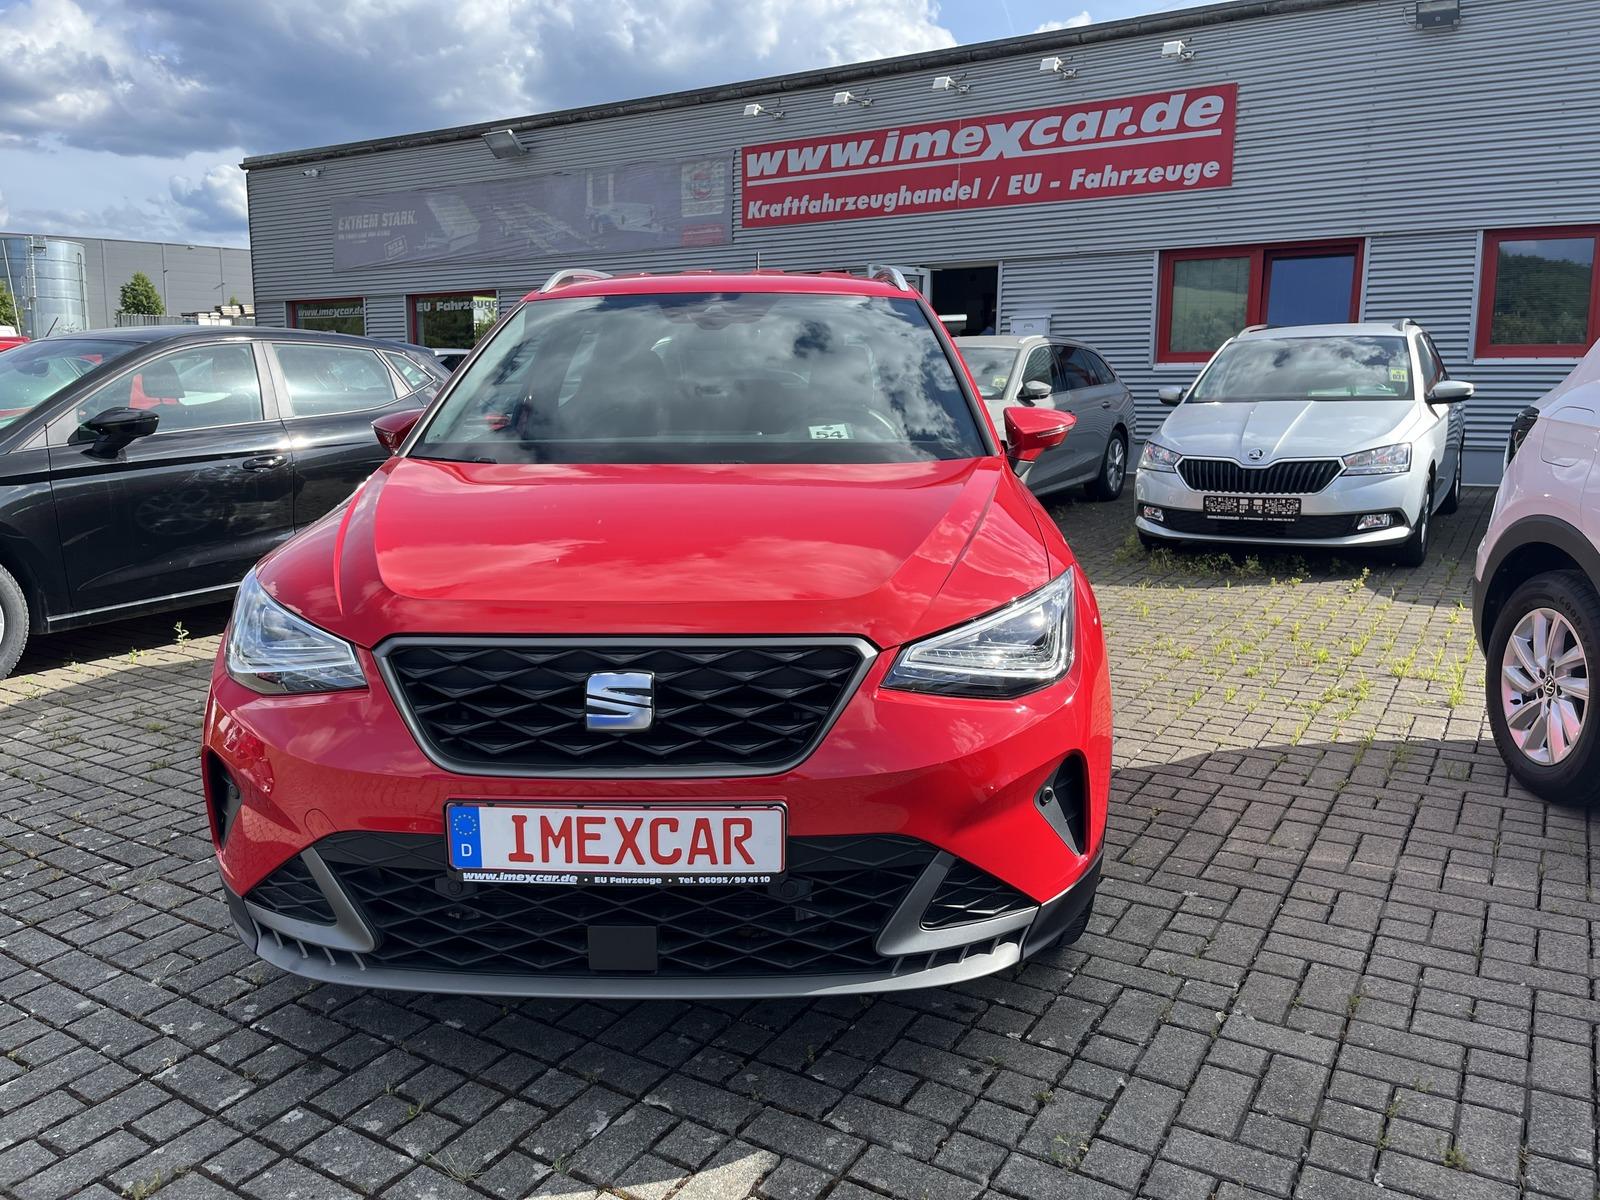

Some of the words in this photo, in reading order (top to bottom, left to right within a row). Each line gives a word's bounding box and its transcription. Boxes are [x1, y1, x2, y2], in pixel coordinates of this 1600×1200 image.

[747, 177, 981, 220] Kraftfahrzeughandel
[1008, 172, 1042, 196] EU
[1070, 158, 1221, 191] Fahrzeuge
[338, 213, 379, 231] EXTREM
[416, 302, 432, 312] EU
[436, 300, 498, 312] Fahrzeuge
[461, 843, 472, 858] D
[508, 814, 755, 866] IMEXCAR
[594, 876, 608, 884] EU
[610, 876, 662, 885] Fahrzeuge
[678, 876, 696, 884] Tel.
